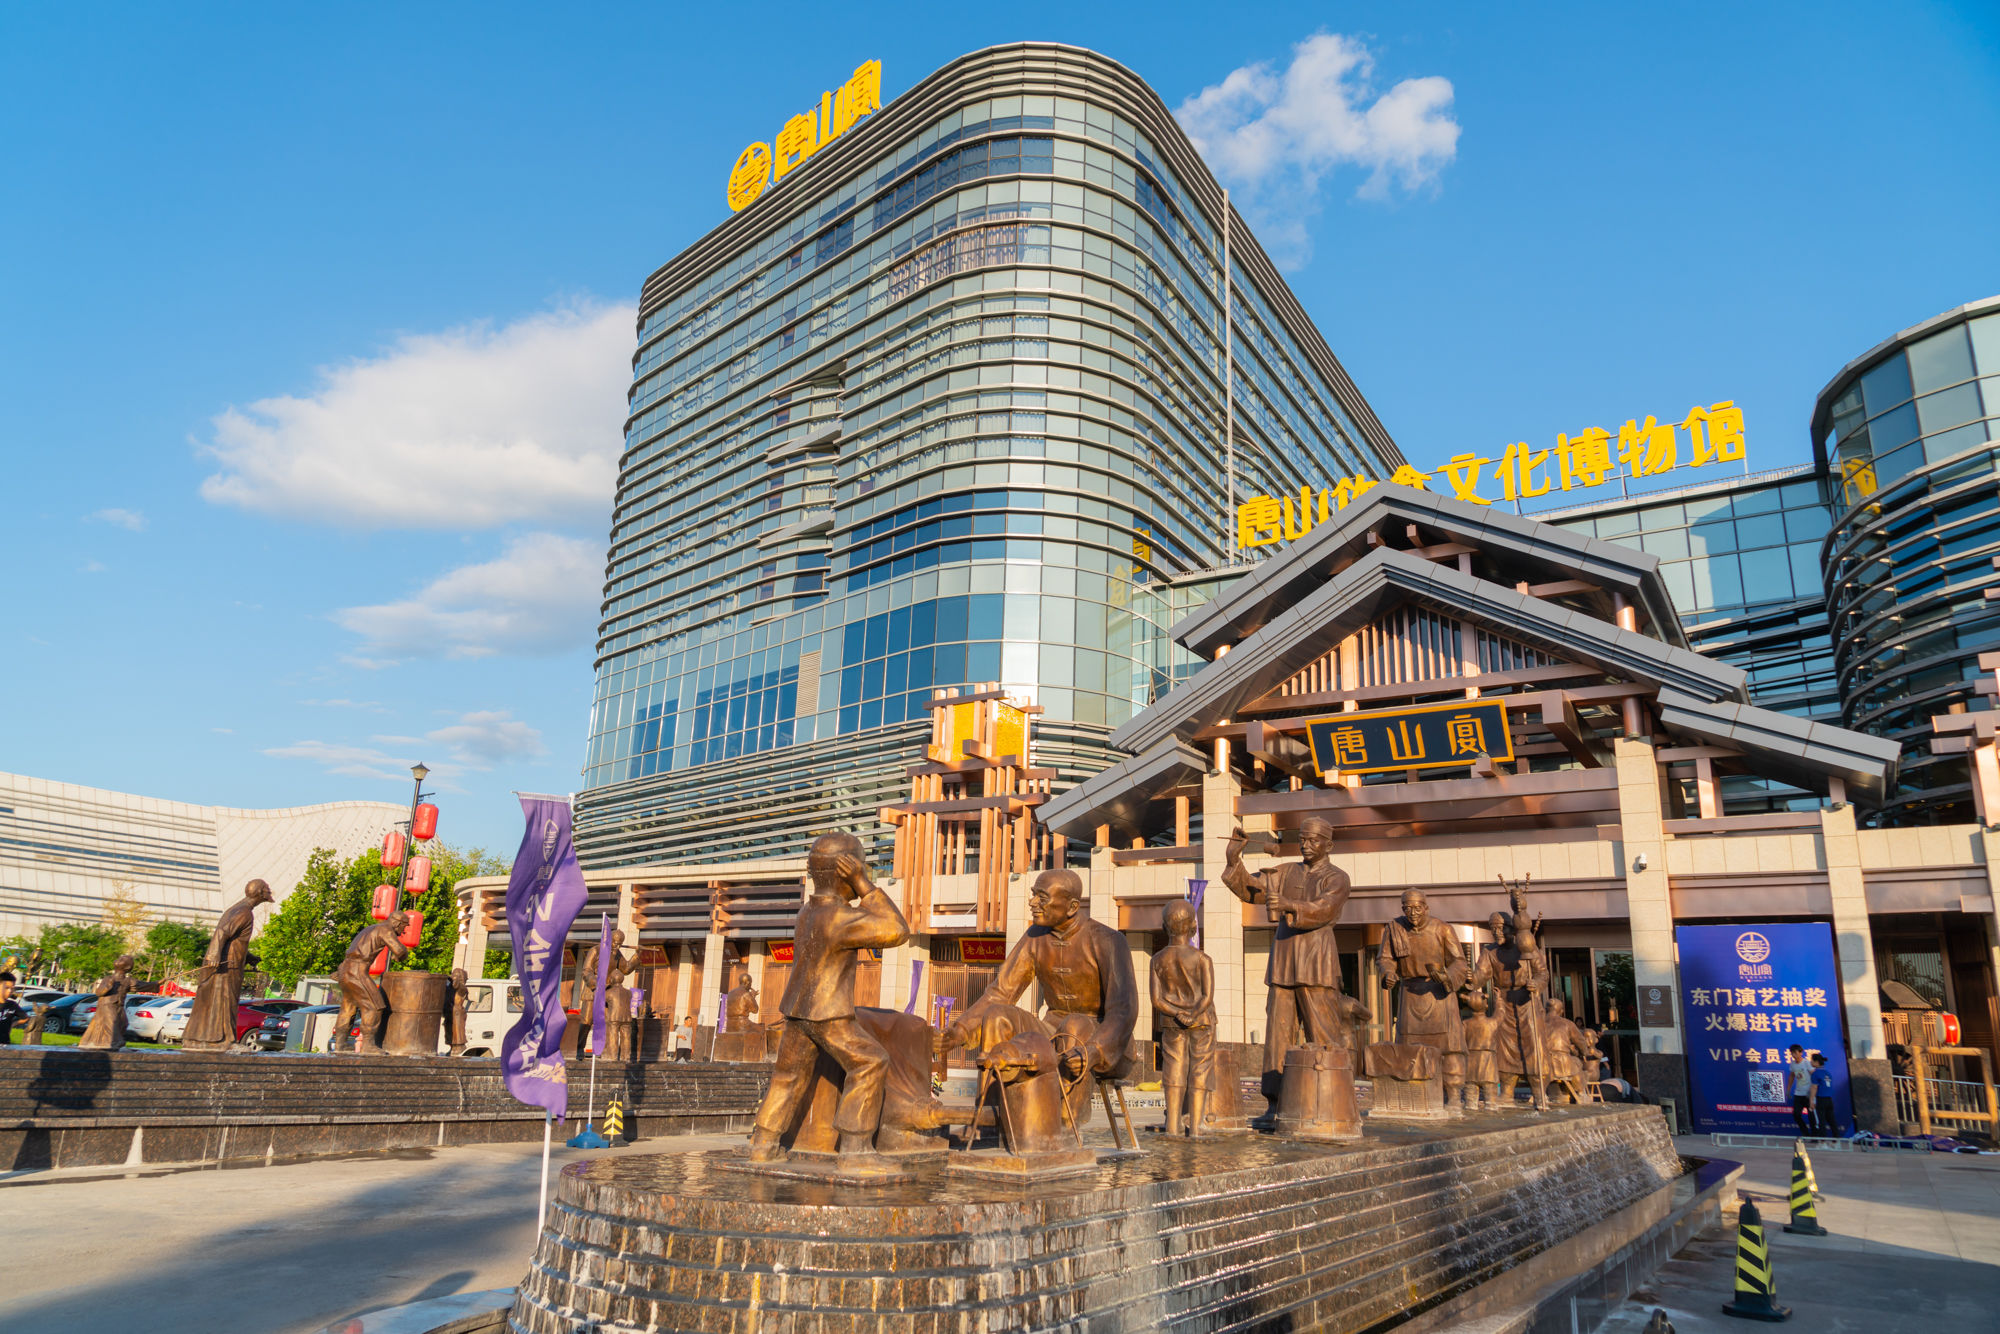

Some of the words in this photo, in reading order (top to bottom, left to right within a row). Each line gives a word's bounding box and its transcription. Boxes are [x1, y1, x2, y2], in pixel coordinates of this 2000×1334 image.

[1329, 713, 1488, 767] 唐山宴
[1690, 987, 1828, 1007] 东门演艺抽奖
[1704, 1012, 1818, 1034] 火爆进行中
